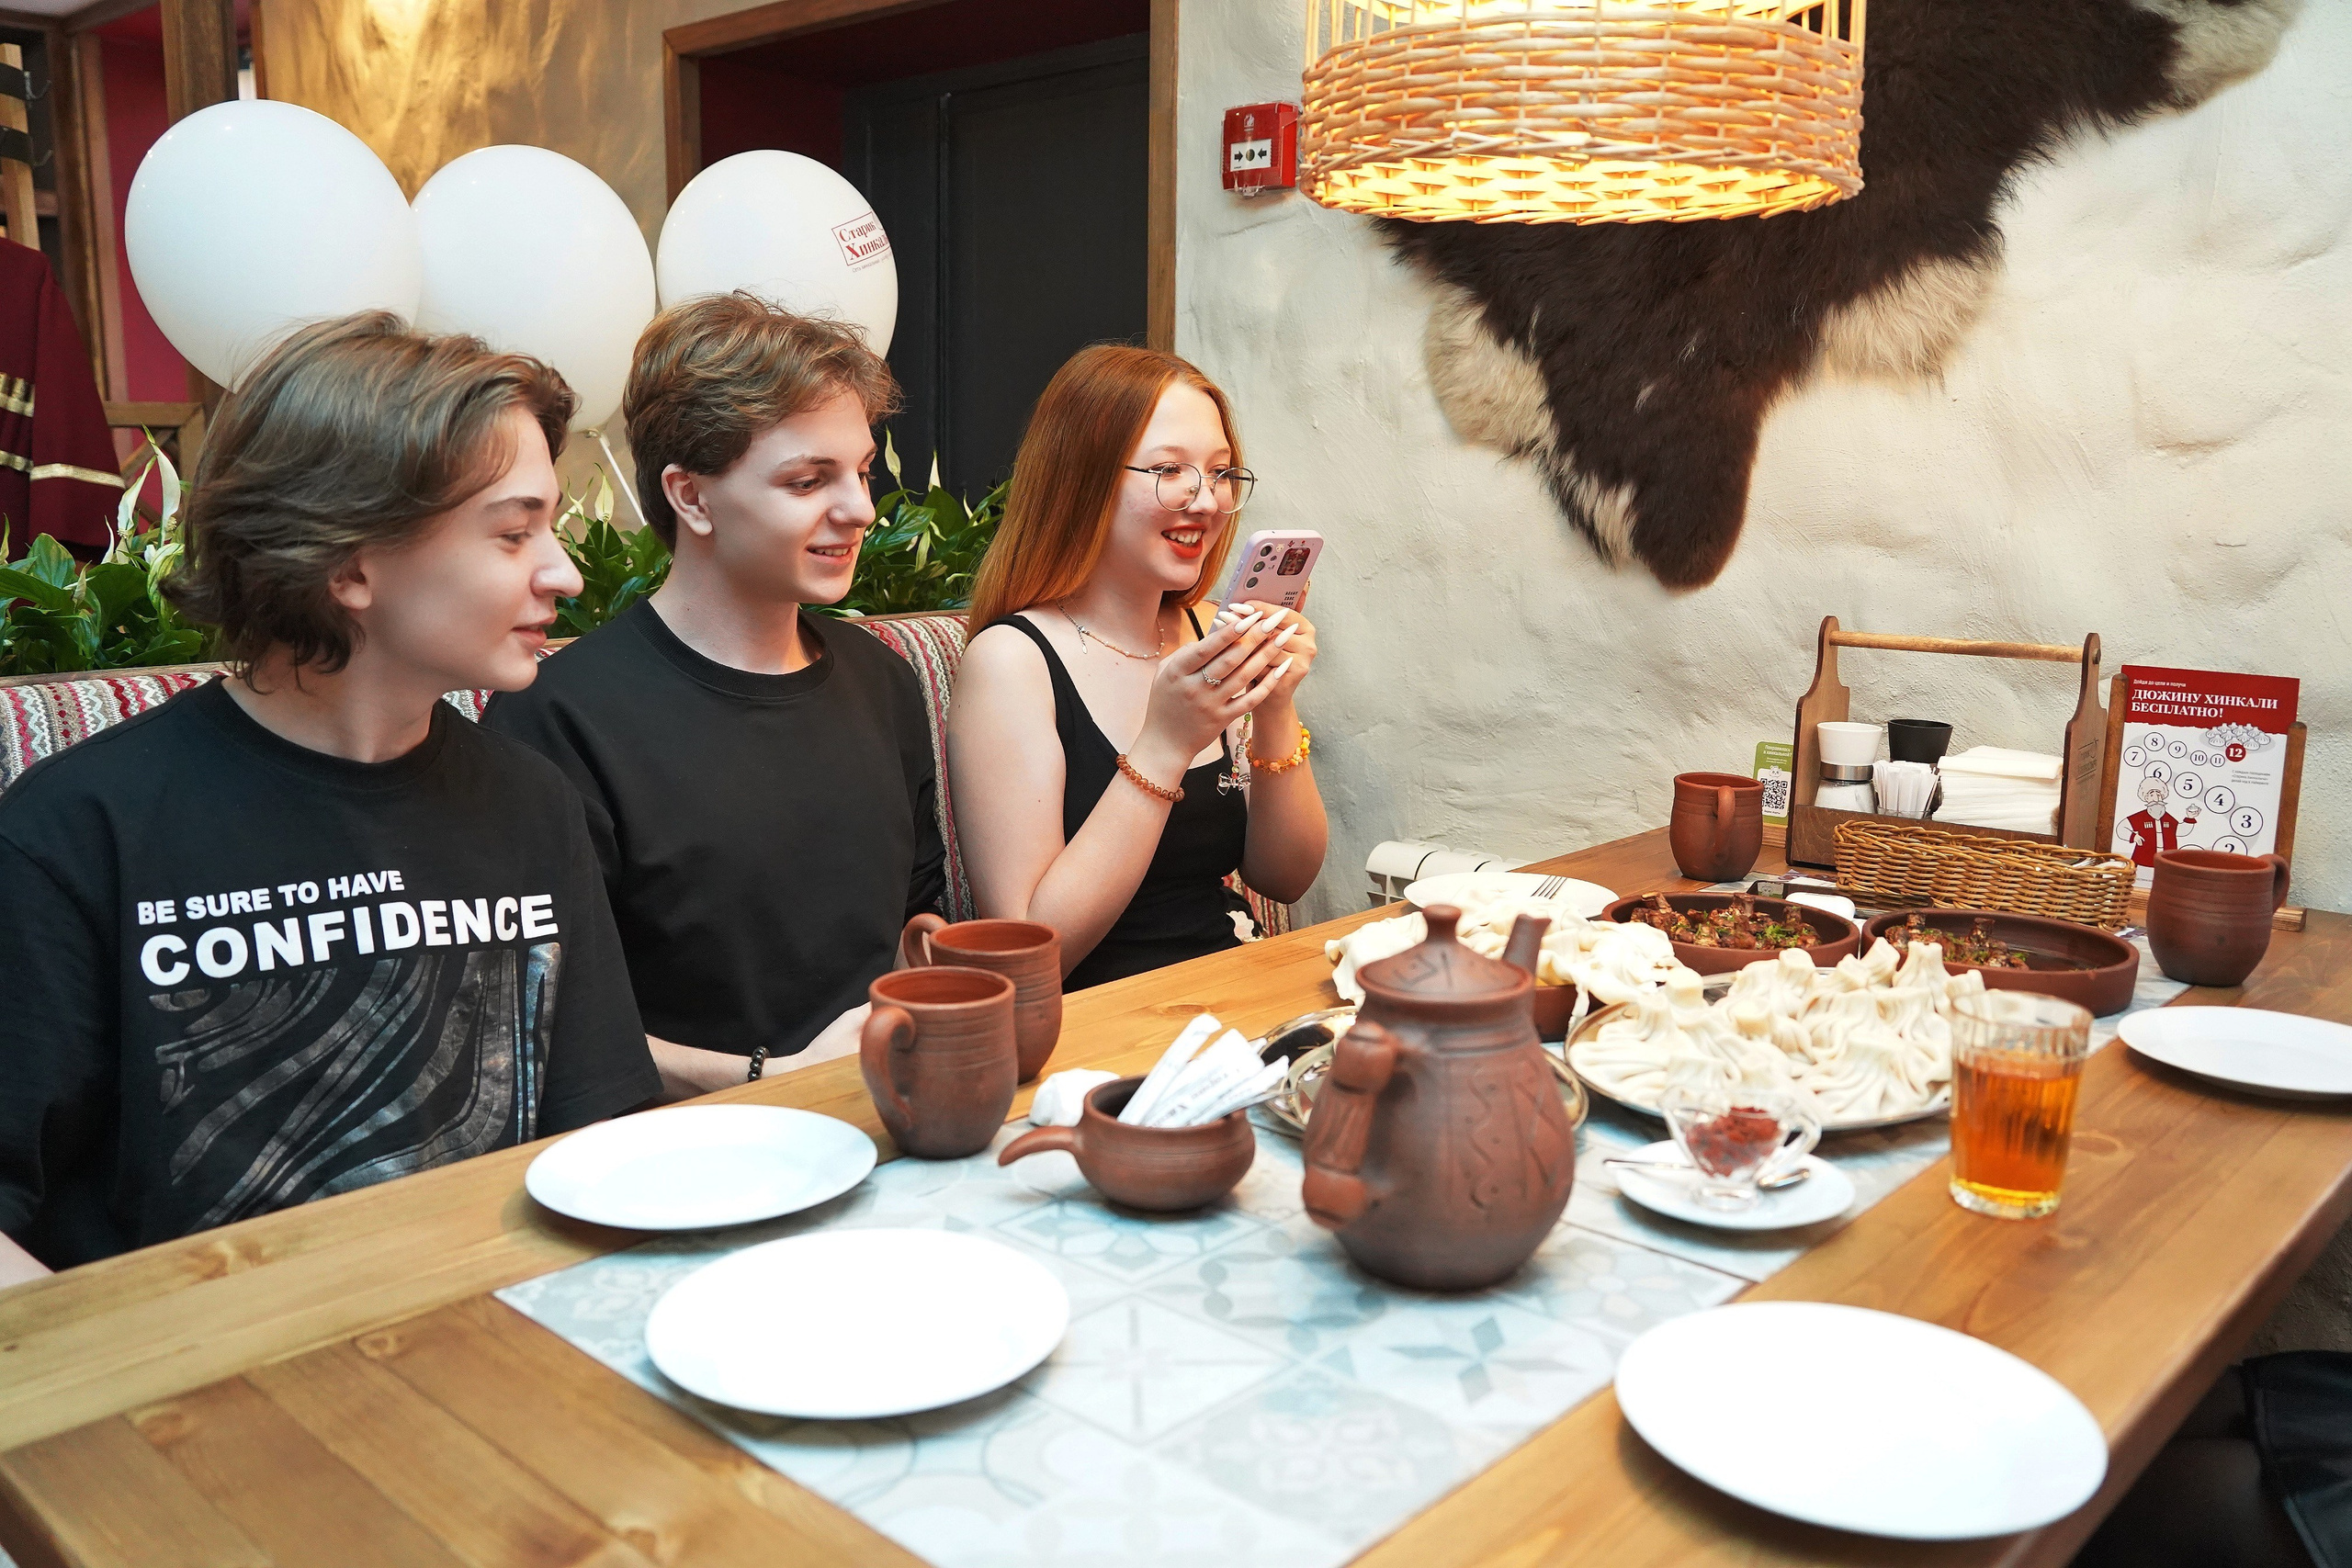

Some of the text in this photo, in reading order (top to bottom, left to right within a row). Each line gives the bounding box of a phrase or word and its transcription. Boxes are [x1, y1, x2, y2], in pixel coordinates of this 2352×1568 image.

[839, 221, 876, 243] Старик
[2132, 689, 2278, 709] ДЮЖИНУ ХИНКАЛИ
[2131, 702, 2223, 718] БЕСПЛАТНО!
[2151, 737, 2158, 747] 8
[2174, 745, 2181, 754] 9
[2229, 748, 2243, 758] 12
[2131, 751, 2139, 761] 7
[2193, 754, 2204, 762] 10
[2153, 766, 2162, 778] 6
[2183, 779, 2193, 791] 5
[2213, 794, 2224, 807] 4
[2240, 814, 2252, 829] 3
[137, 870, 405, 925] BE SURE TO HAVE
[140, 894, 559, 987] CONFIDENCE
